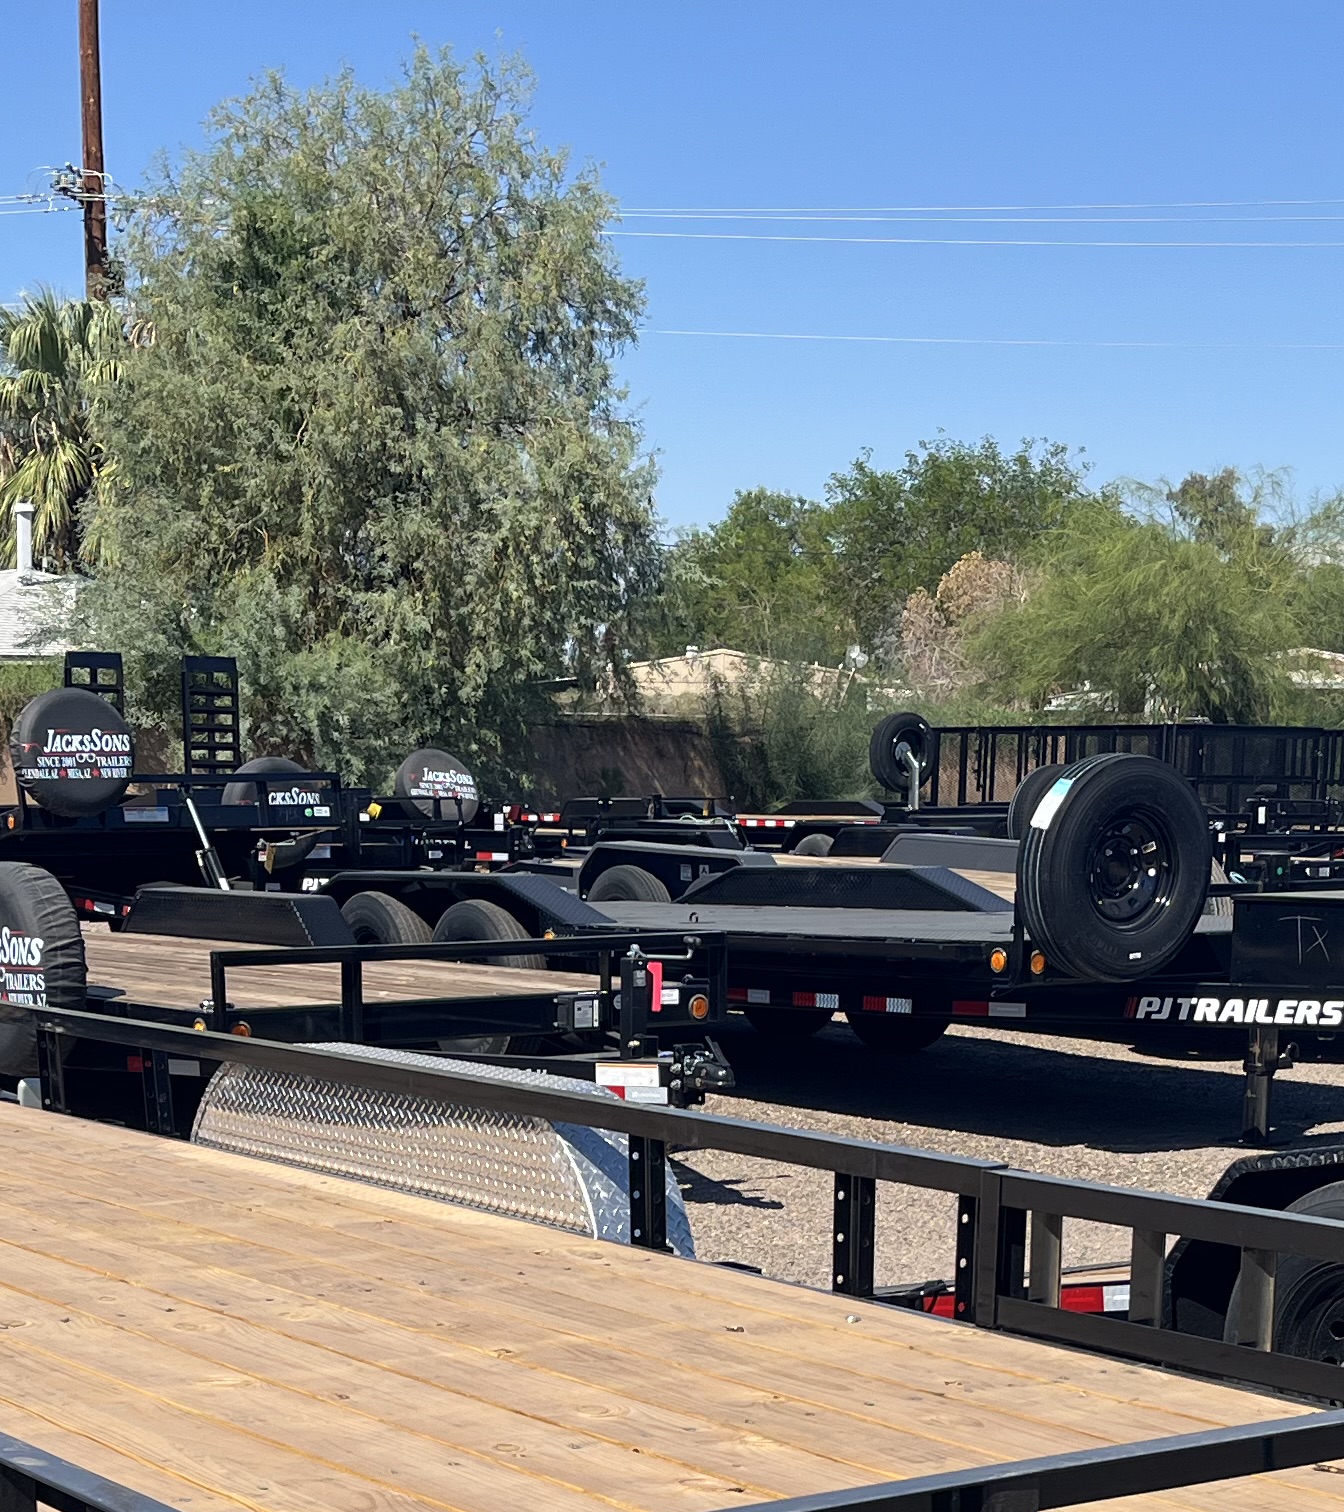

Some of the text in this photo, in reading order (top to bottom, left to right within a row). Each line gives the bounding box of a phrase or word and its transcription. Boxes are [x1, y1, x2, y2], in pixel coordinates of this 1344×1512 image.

[36, 756, 61, 768] SINCE
[267, 787, 321, 806] CKSSONS
[5, 972, 46, 991] TRAILERS
[1135, 996, 1174, 1020] PJ
